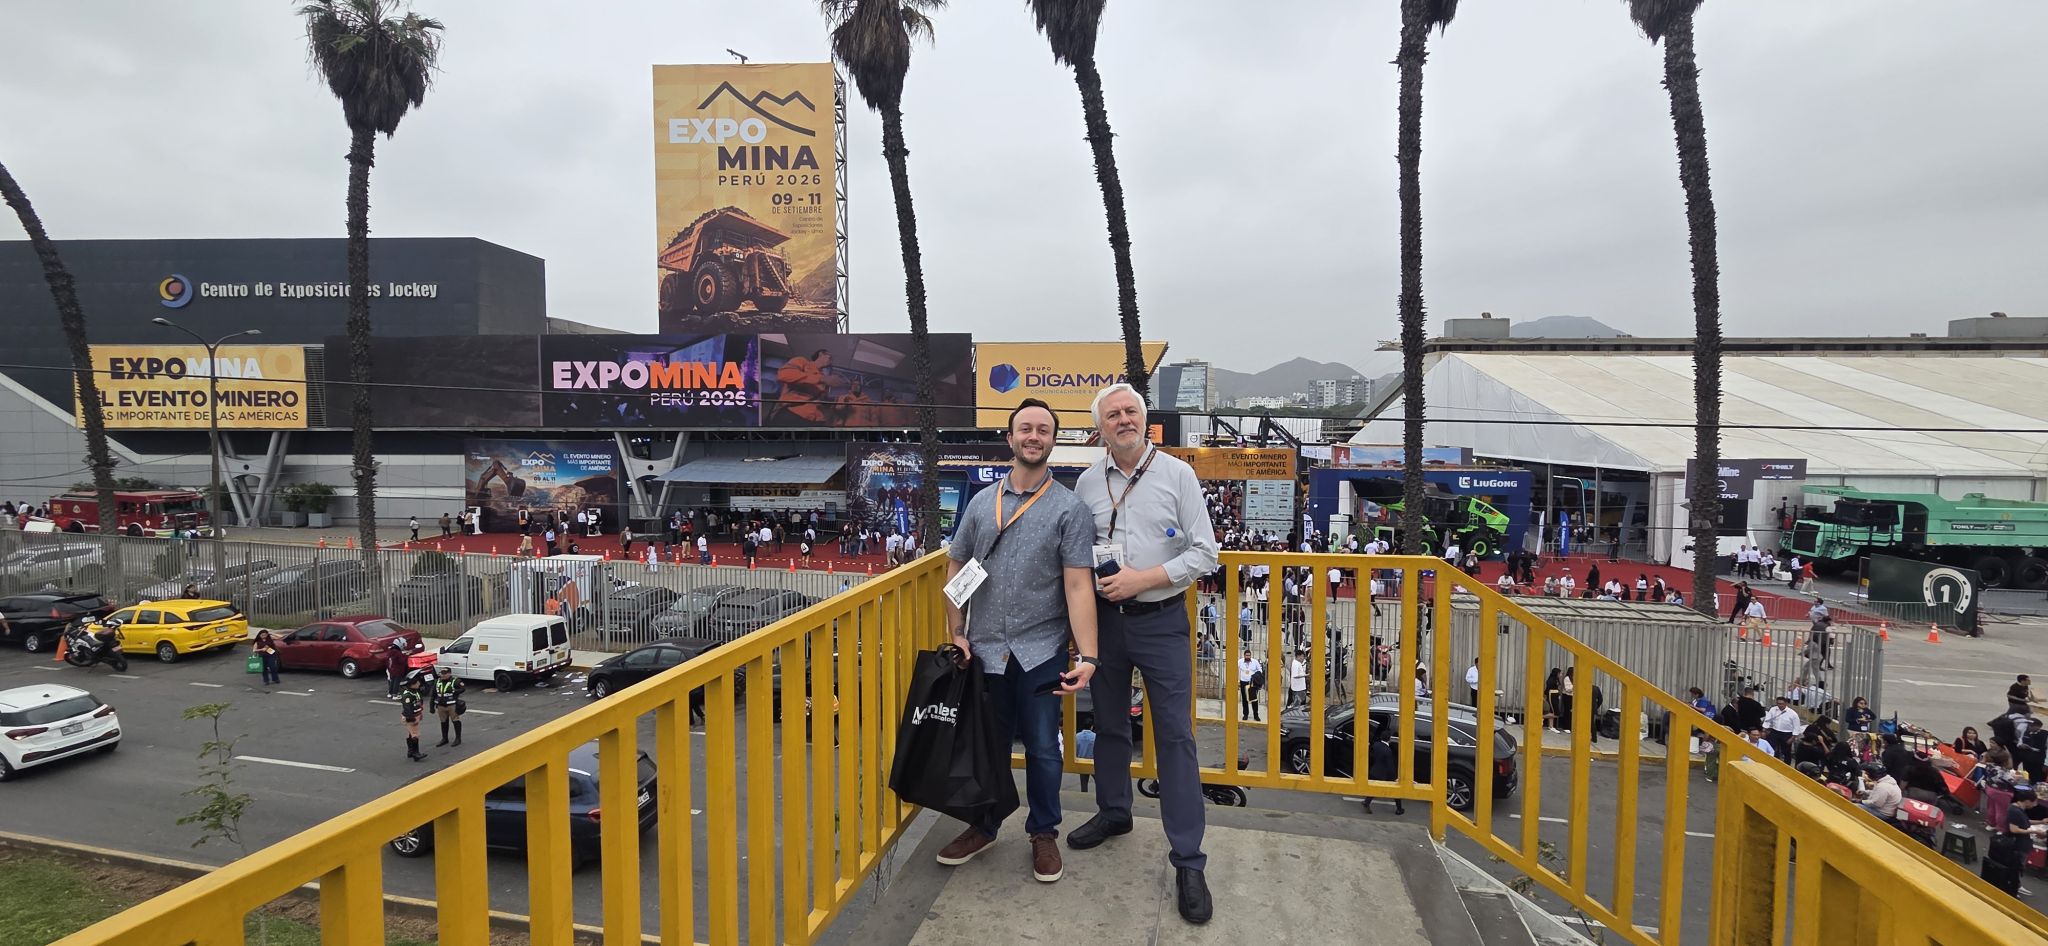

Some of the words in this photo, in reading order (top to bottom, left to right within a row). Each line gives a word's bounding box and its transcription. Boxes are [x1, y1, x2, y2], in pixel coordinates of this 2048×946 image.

[668, 117, 767, 144] EXPO
[717, 145, 820, 171] MINA
[718, 173, 766, 186] PERÚ
[776, 174, 821, 186] 2026
[771, 192, 793, 206] 09
[808, 192, 821, 205] 11
[771, 206, 781, 215] DE
[783, 205, 822, 214] SETIEMBRE
[200, 282, 249, 298] Centro
[254, 282, 273, 297] de
[279, 282, 381, 299] Exposicios
[389, 282, 438, 298] Jockey
[109, 357, 264, 380] EXPOMINA
[553, 361, 744, 389] EXPOMINA
[1025, 373, 1129, 388] DIGAMMA
[119, 391, 208, 407] EVENTO
[216, 391, 299, 407] MINERO
[650, 390, 694, 406] PERÚ
[699, 391, 747, 406] 2026
[117, 411, 191, 421] IMPORTANTE
[194, 411, 210, 421] DE
[239, 409, 299, 421] AMÉRICAS
[1256, 468, 1287, 476] AMÉRICA
[1940, 584, 1950, 603] 1
